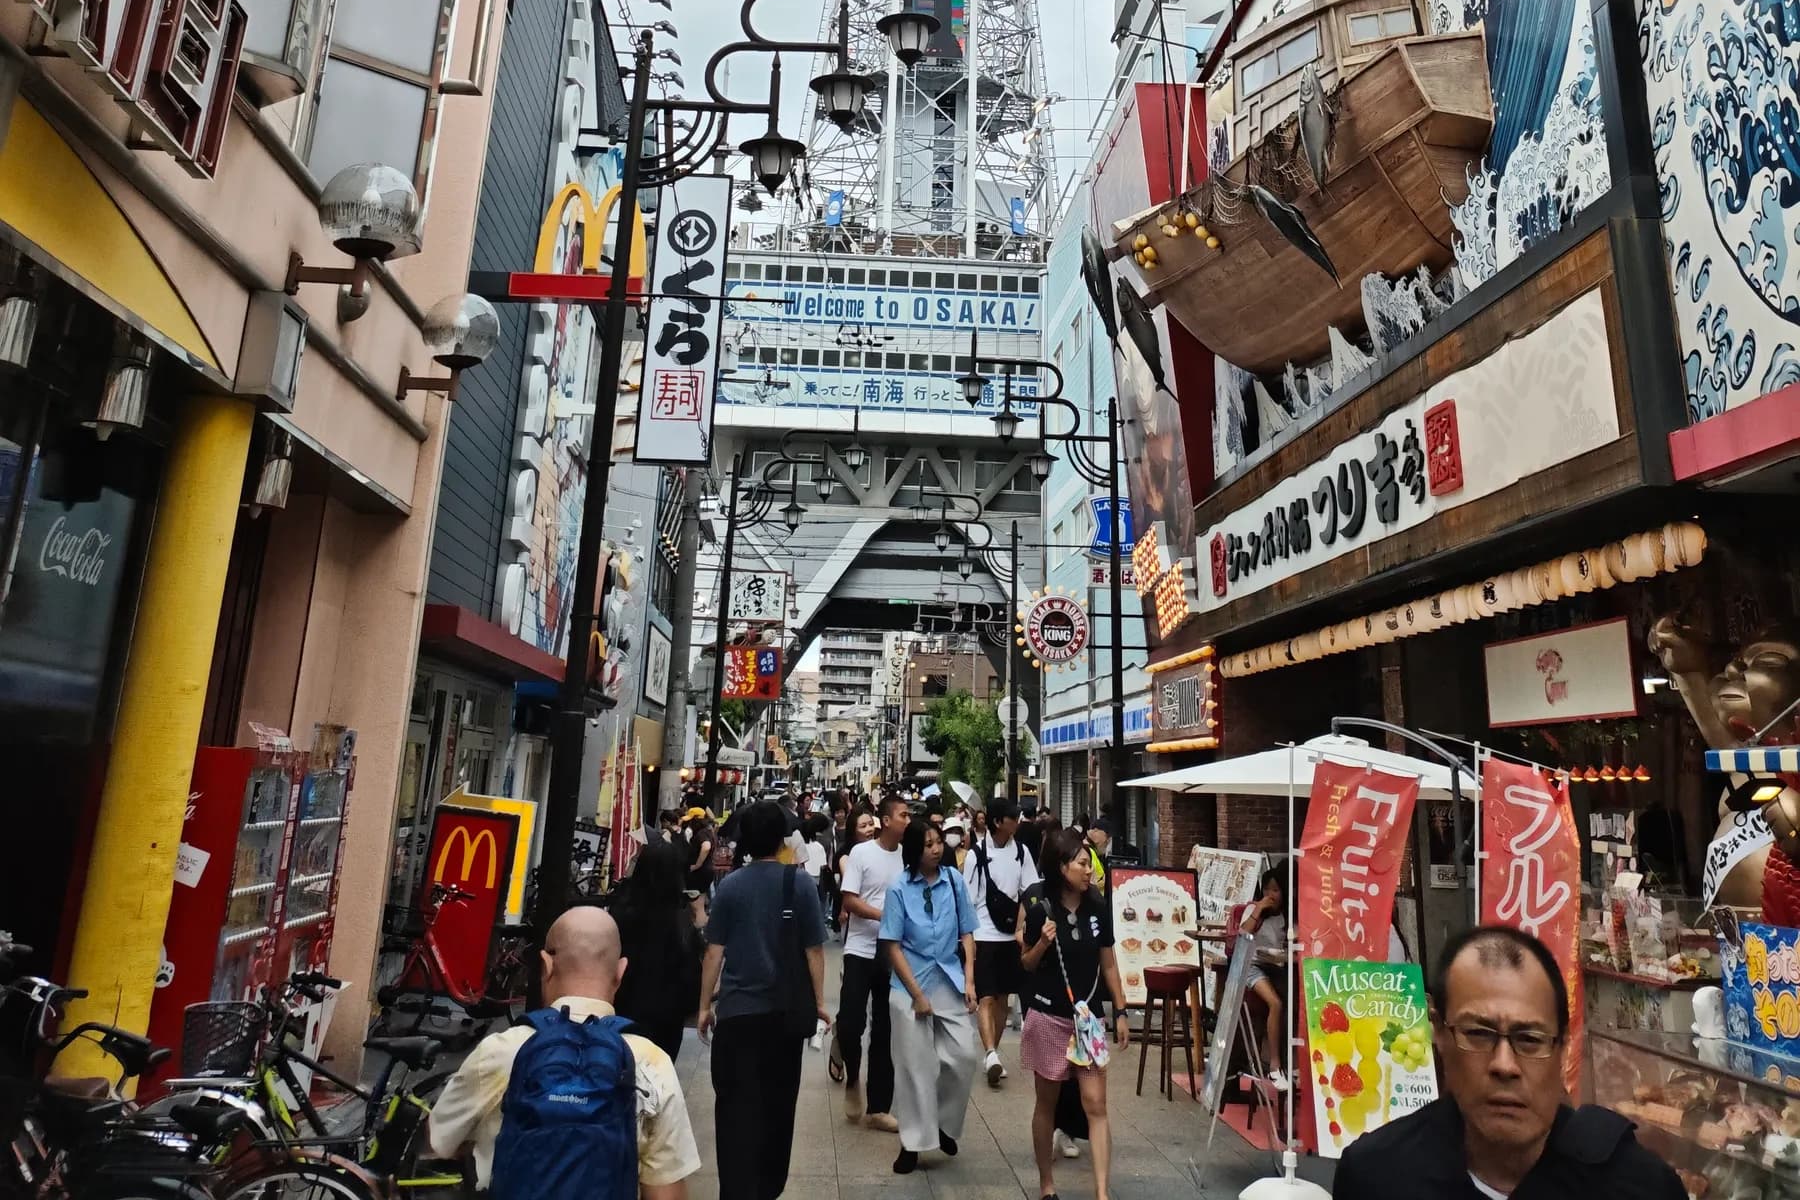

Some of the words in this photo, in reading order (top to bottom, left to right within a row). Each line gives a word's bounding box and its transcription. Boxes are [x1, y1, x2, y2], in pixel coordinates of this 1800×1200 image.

[655, 259, 715, 366] くら
[784, 291, 864, 319] Welcome
[875, 295, 899, 320] to
[913, 297, 1036, 327] OSAKA!
[655, 373, 700, 416] 寿司
[863, 379, 904, 404] 南海
[1096, 501, 1132, 512] LASO
[1030, 601, 1051, 630] STEAK
[1063, 603, 1085, 630] HOUSE
[1043, 647, 1072, 659] OSAKA
[1044, 630, 1071, 641] KING
[1325, 784, 1348, 836] Fresh
[1319, 844, 1334, 858] &
[1341, 785, 1400, 944] Fruits
[1496, 784, 1570, 938] フル
[1128, 886, 1154, 899] Festival
[1156, 886, 1180, 901] Sweets
[1317, 865, 1335, 920] Juicy
[1310, 965, 1408, 1000] Muscat
[1346, 993, 1426, 1029] Candy
